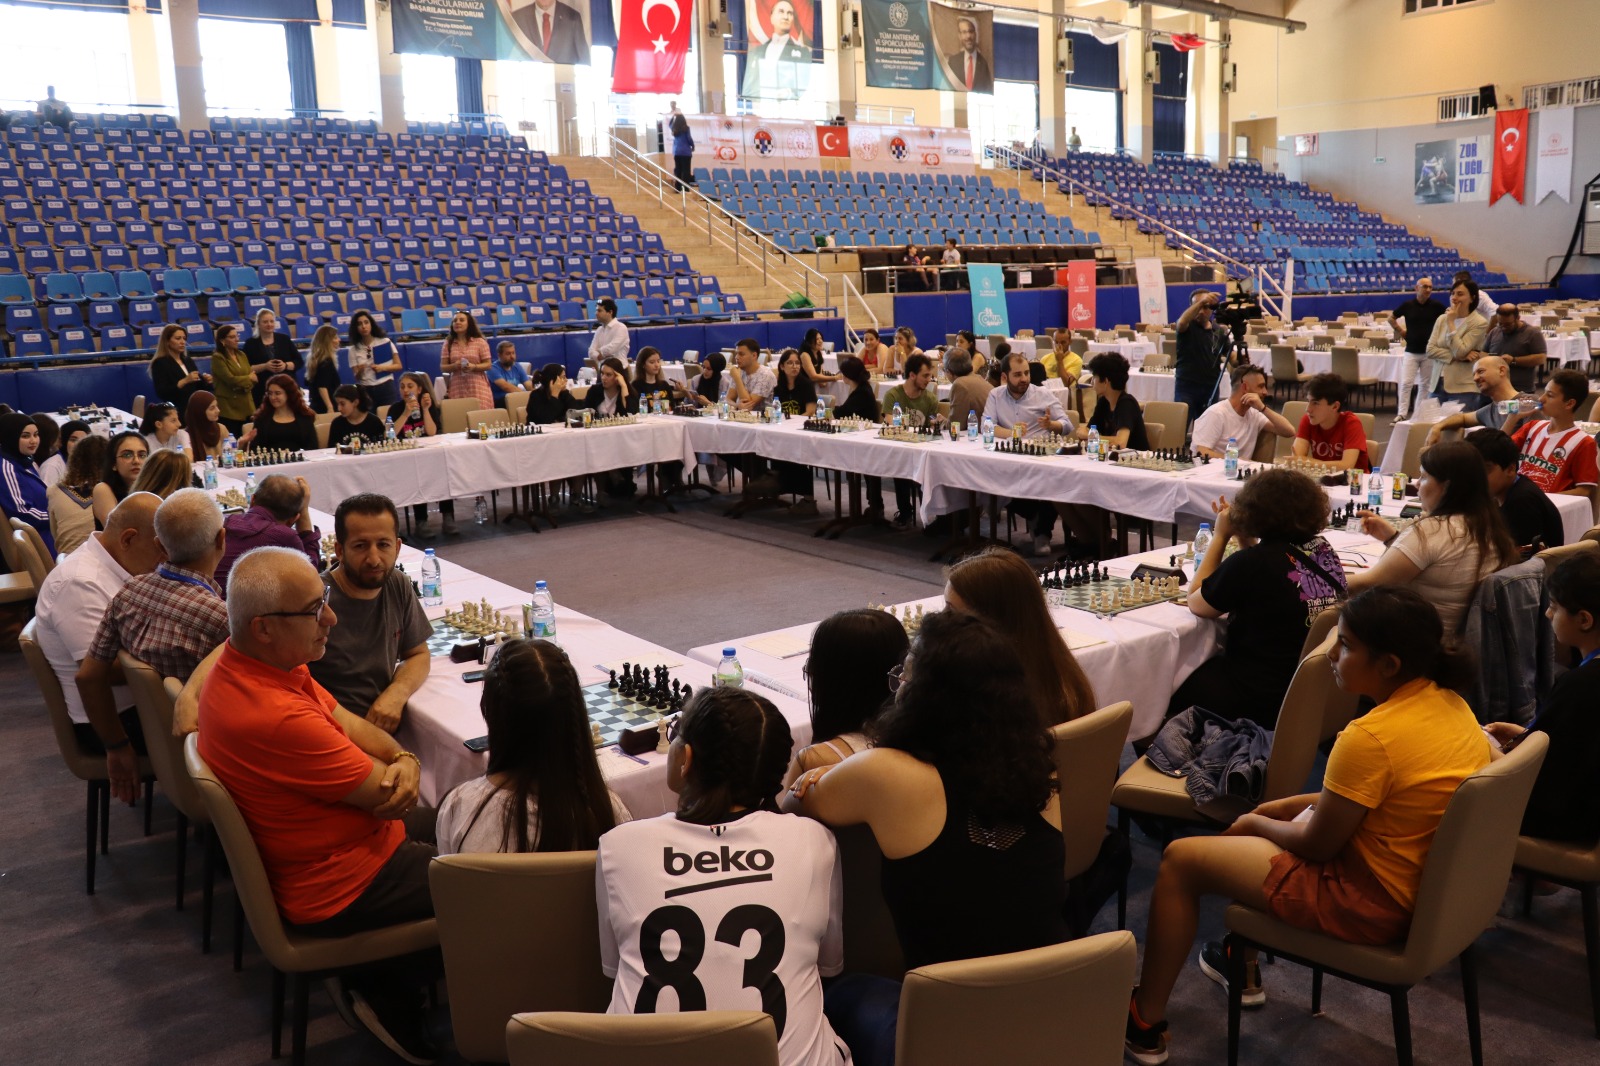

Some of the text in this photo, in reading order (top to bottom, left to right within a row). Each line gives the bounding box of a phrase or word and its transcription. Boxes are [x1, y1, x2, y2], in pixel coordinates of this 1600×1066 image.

[410, 2, 484, 18] BAŞARILAR DİLİYORUM
[879, 32, 892, 40] TÜM
[1460, 143, 1478, 158] ZOR
[1460, 160, 1482, 176] LUĞU
[1459, 178, 1476, 193] YEN
[1520, 452, 1558, 474] aroma
[664, 846, 774, 876] beko
[634, 904, 787, 1042] 83
